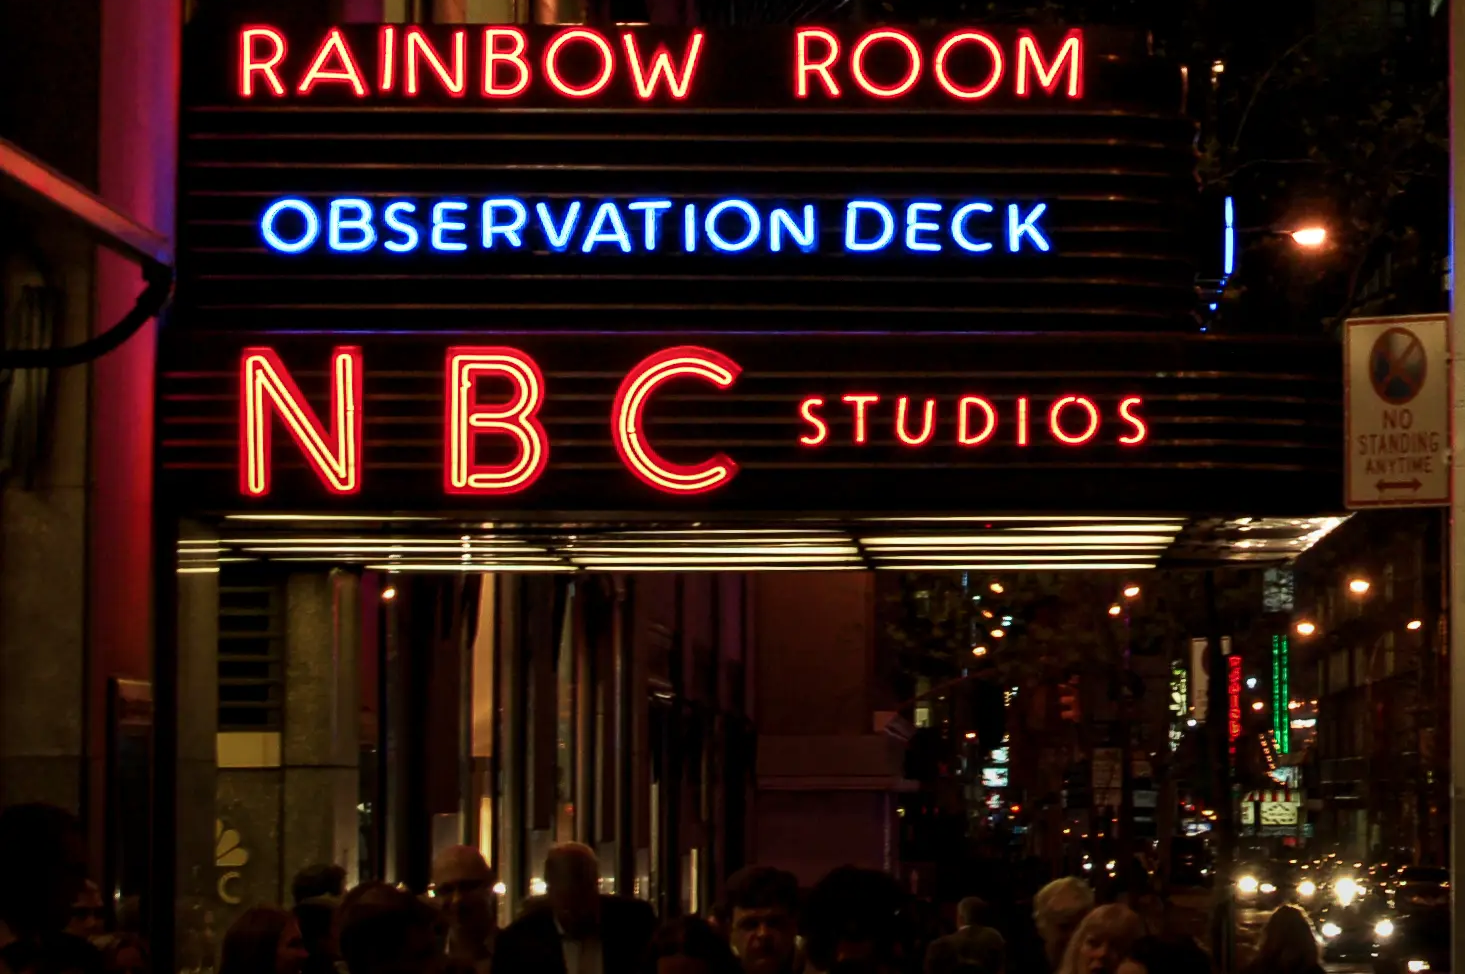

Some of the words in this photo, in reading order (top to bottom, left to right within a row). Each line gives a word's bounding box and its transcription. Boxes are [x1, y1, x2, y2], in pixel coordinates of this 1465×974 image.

[238, 26, 705, 101] RAINBOW
[794, 26, 1084, 101] ROOM
[257, 195, 819, 255] OBSERVATION
[842, 197, 1051, 255] DECK
[239, 345, 742, 497] NBC
[798, 393, 1149, 447] STUDIOS
[1382, 409, 1413, 430] NO
[1357, 431, 1440, 456] STANDING
[1365, 456, 1434, 475] ANYTIME
